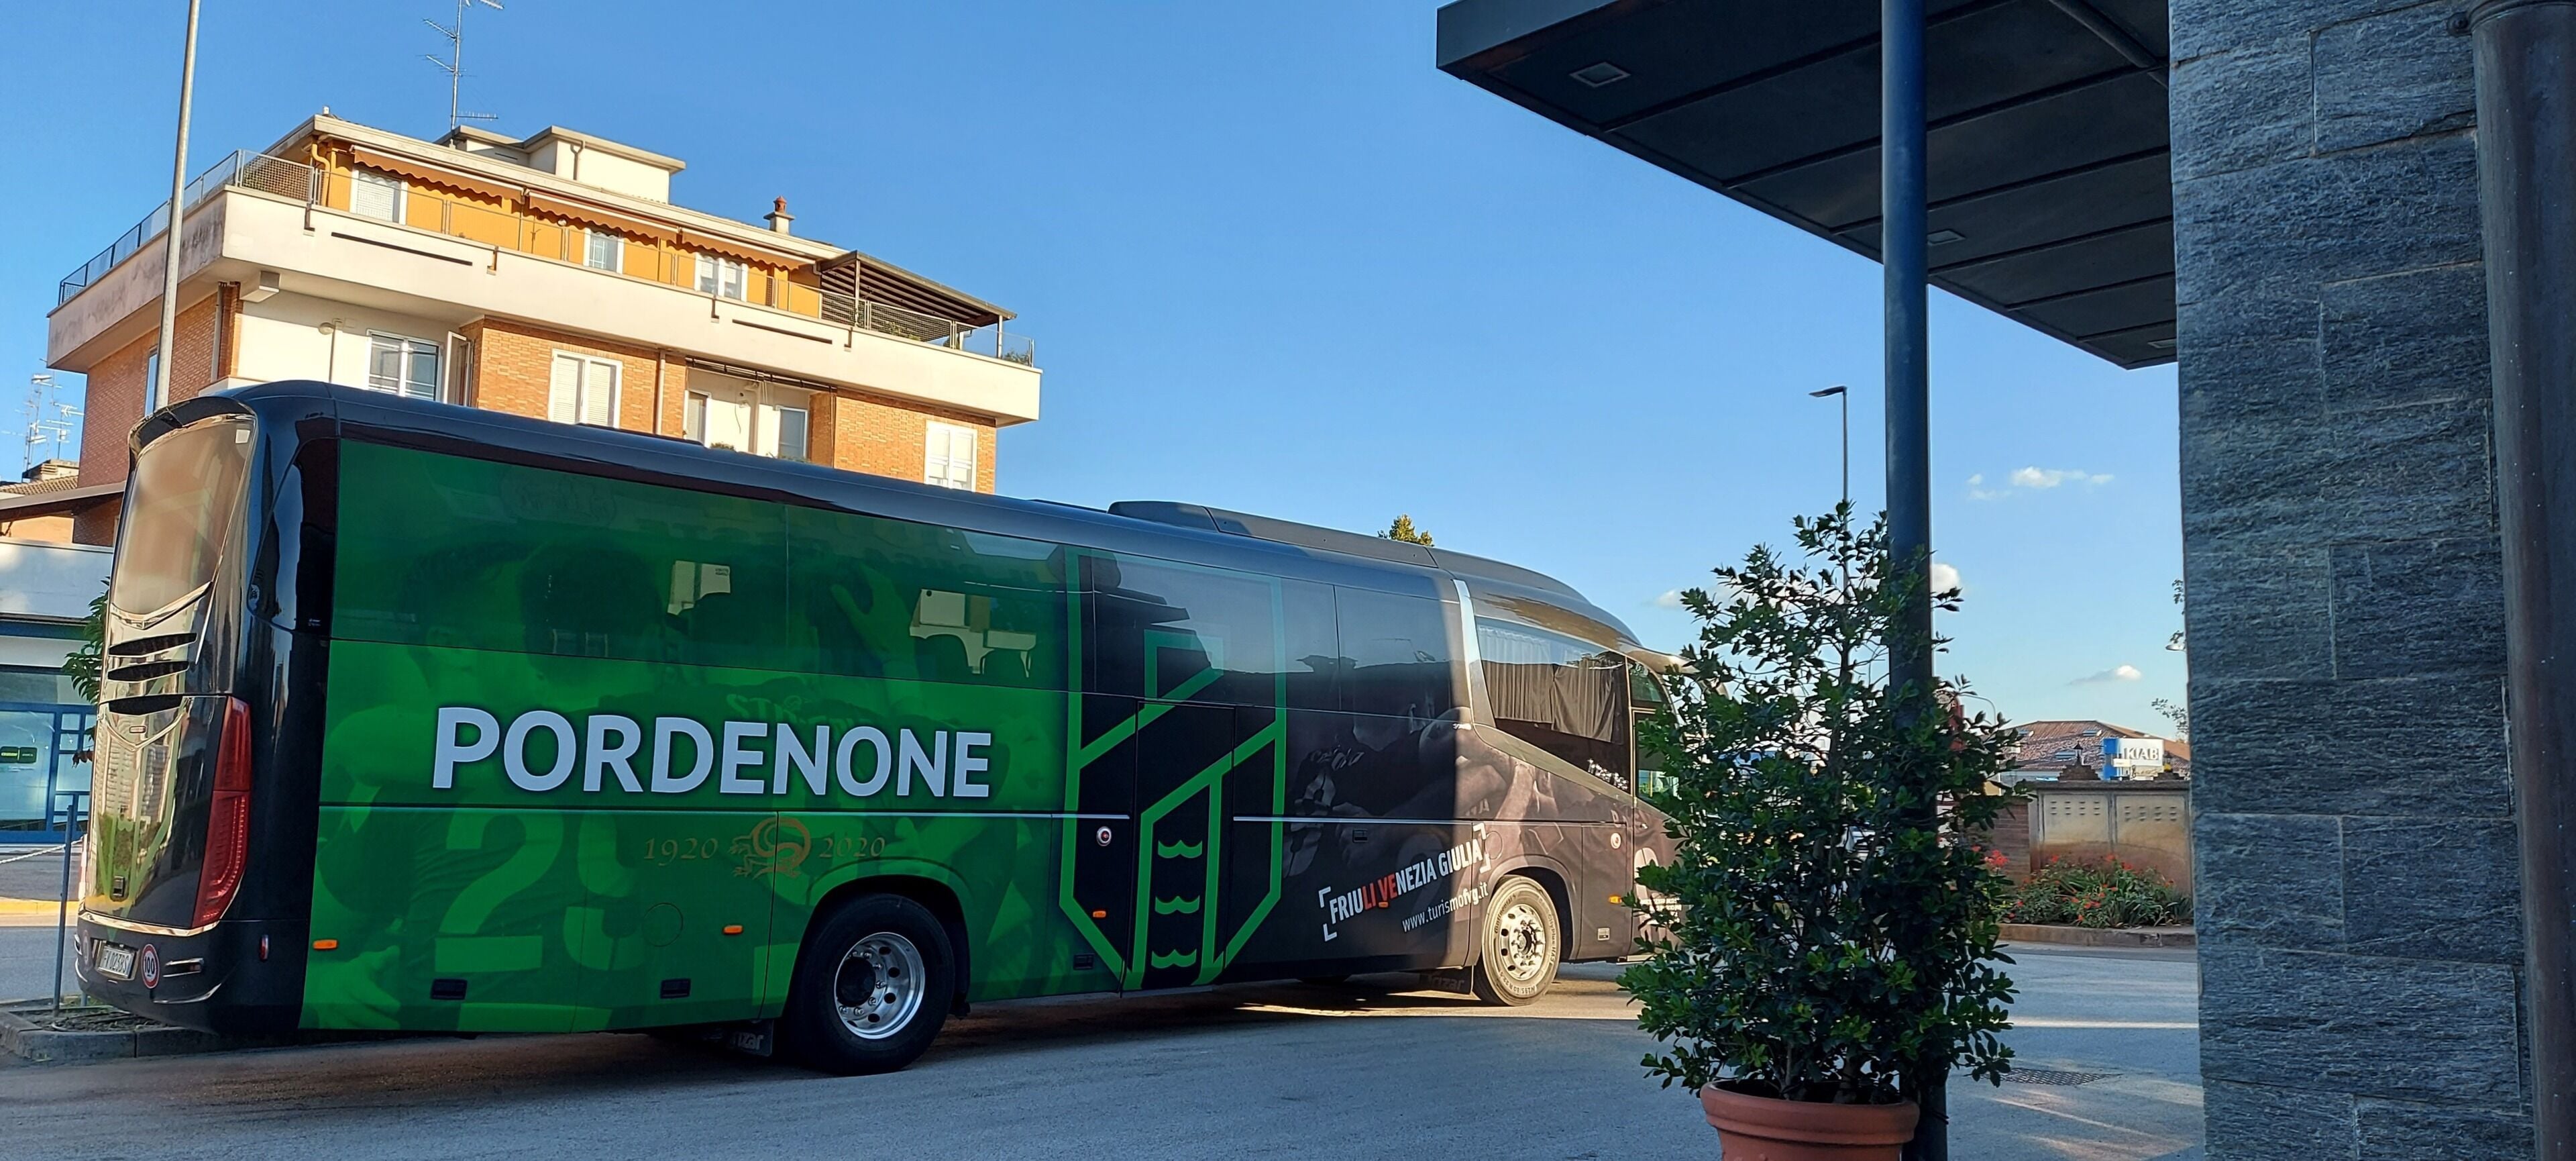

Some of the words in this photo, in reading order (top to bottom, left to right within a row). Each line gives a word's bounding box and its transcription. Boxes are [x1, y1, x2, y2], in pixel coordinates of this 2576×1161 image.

[433, 707, 991, 797] PORDENONE
[643, 838, 718, 866] 1920
[819, 837, 885, 858] 2020
[1329, 882, 1376, 924] FRIULI
[1377, 858, 1437, 902] VENEZIA
[1438, 838, 1483, 876] GIULIA
[1402, 882, 1489, 933] www.turismofvg.it
[144, 956, 155, 974] 100
